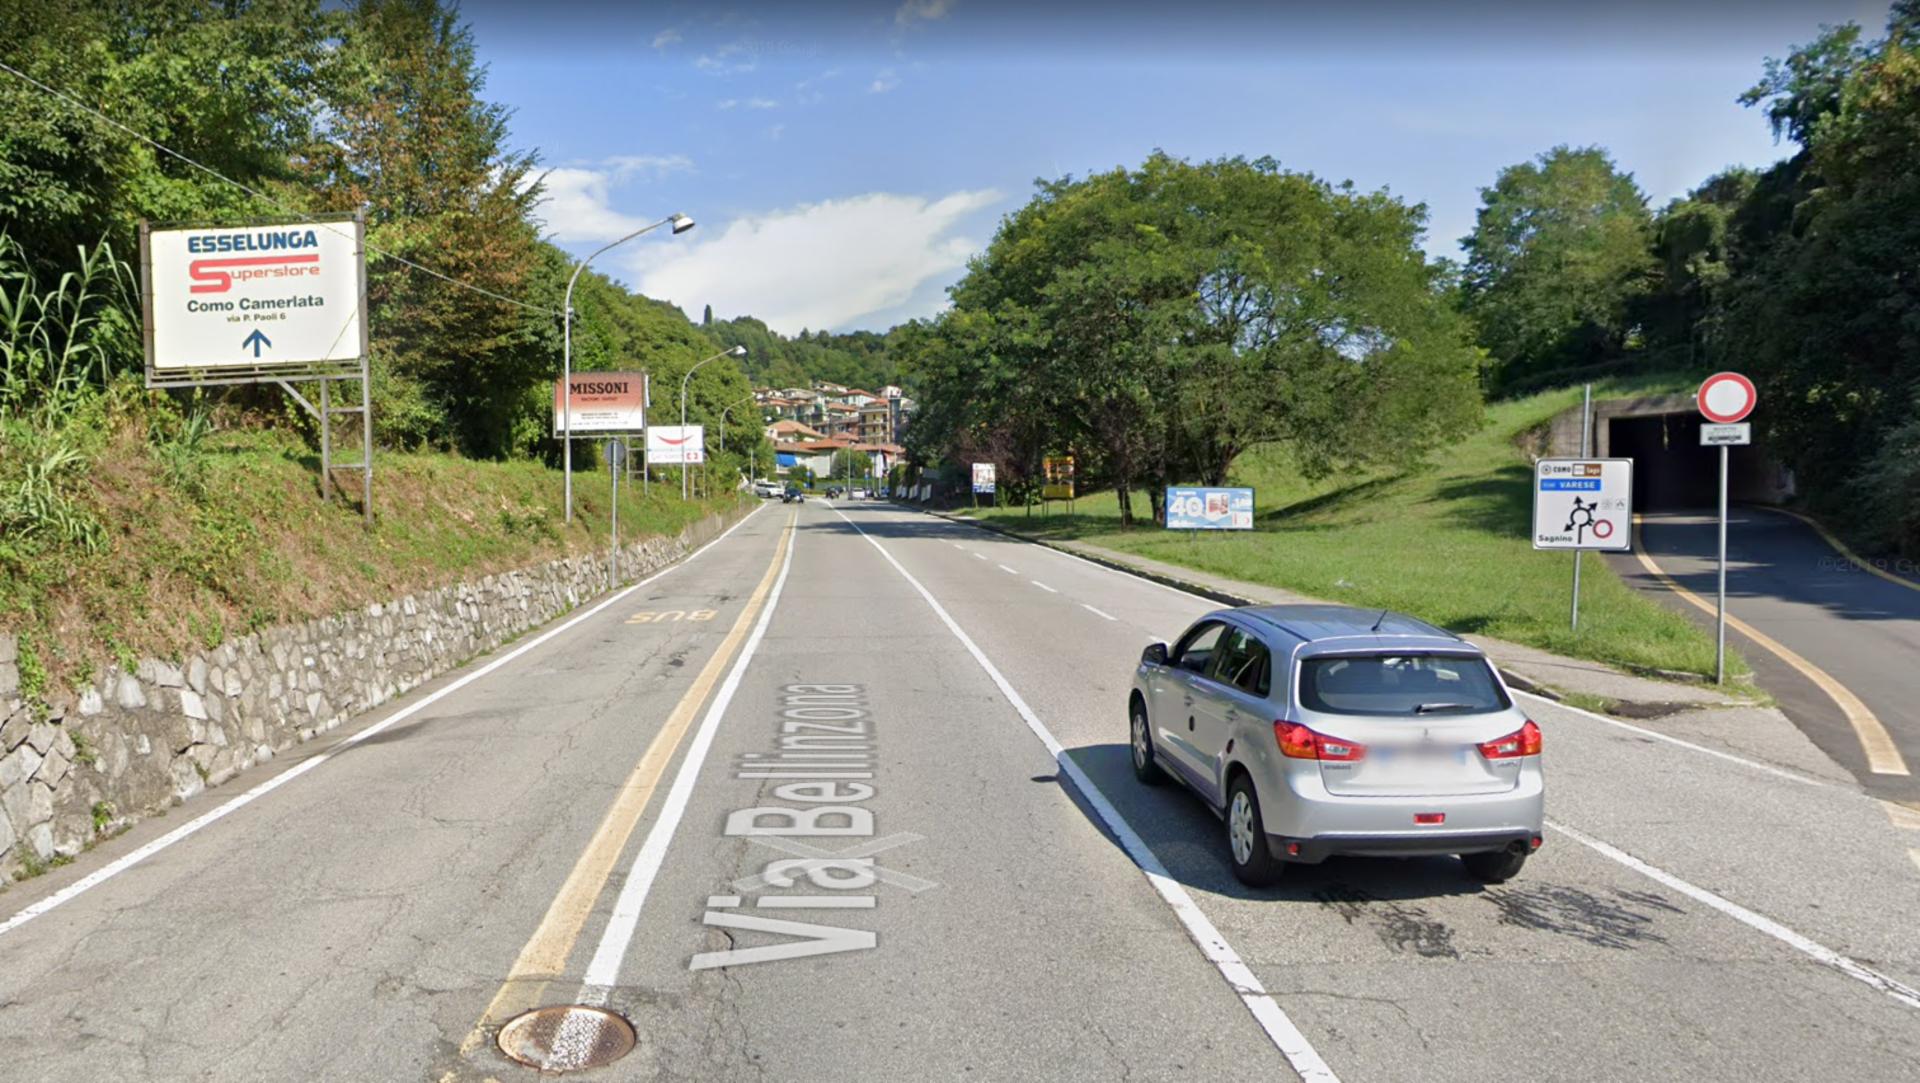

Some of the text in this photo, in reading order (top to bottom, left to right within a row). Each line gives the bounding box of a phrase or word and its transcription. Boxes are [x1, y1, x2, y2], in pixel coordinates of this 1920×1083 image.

[188, 230, 318, 253] ESSELUNGA
[189, 254, 320, 294] Superstore
[187, 295, 325, 313] Como Camerlata
[227, 314, 241, 322] via
[254, 313, 278, 321] Paoli
[569, 382, 629, 395] MISSONI
[1560, 481, 1596, 489] VARESE
[1539, 534, 1573, 543] Sagnino
[624, 609, 719, 624] BUS
